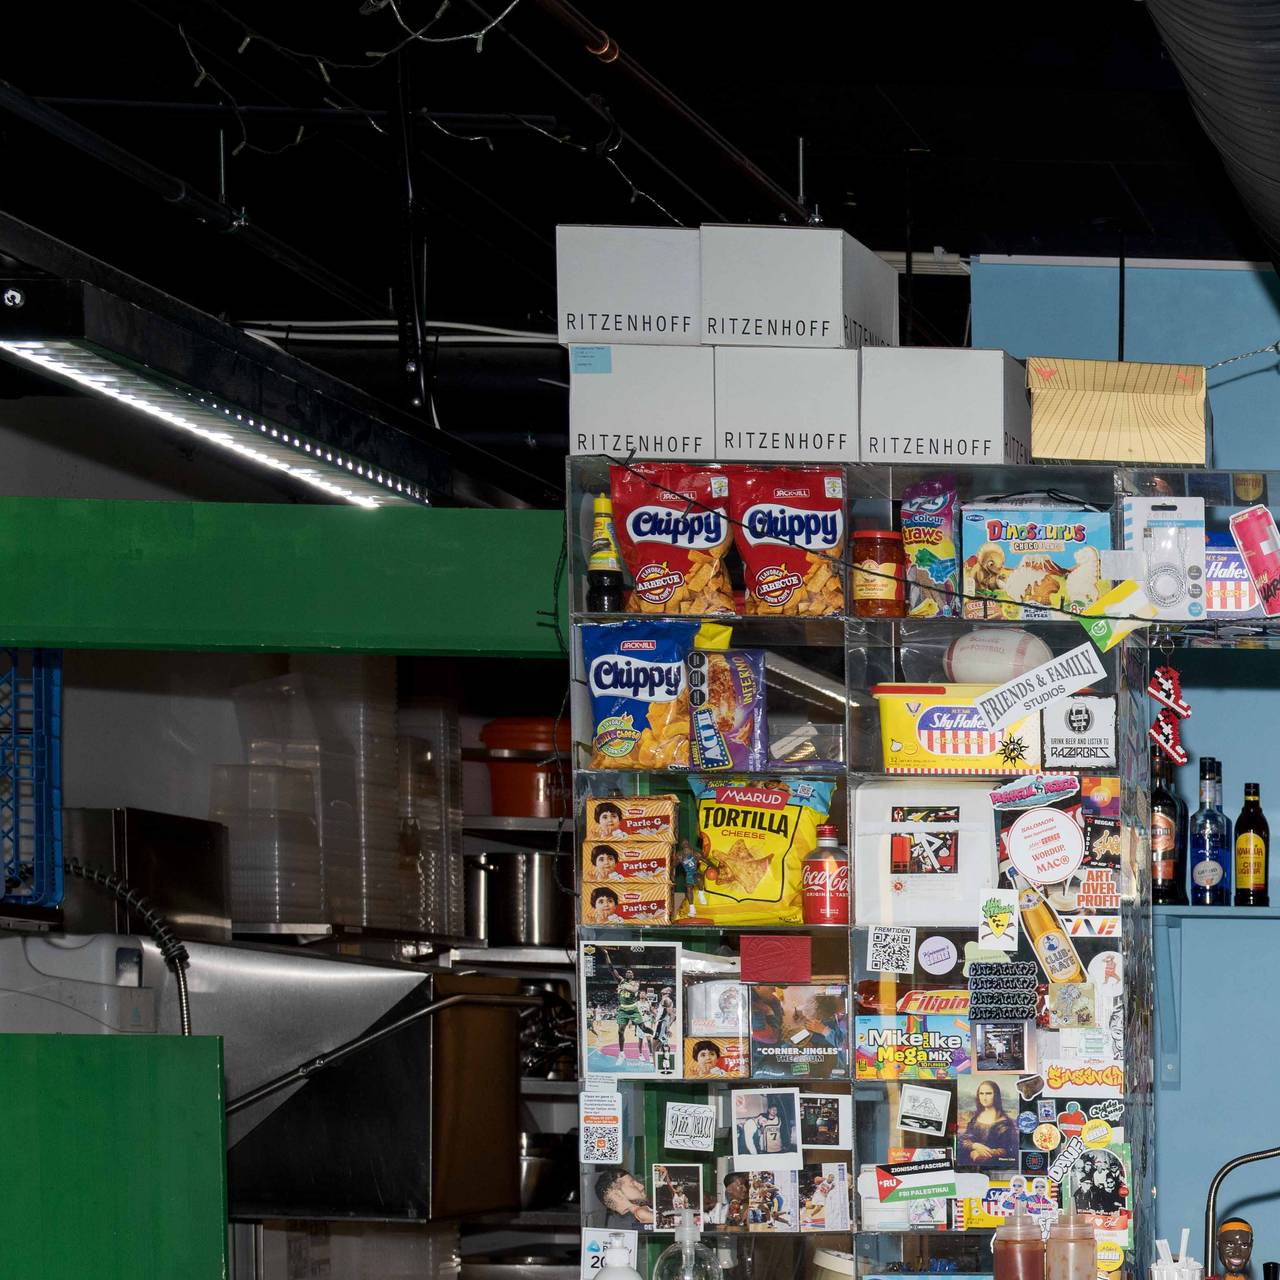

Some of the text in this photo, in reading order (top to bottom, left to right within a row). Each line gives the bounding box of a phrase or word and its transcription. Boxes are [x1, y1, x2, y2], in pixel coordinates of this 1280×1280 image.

[566, 313, 693, 333] RITZENHOFF
[707, 317, 831, 337] RITZENHOFF
[577, 433, 703, 454] RITZENHOFF
[723, 431, 848, 451] RITZENHOFF
[868, 436, 994, 457] RITZENHOFF
[631, 507, 723, 547] Chippy
[747, 506, 843, 547] Chippy
[593, 660, 682, 699] Chippy
[732, 655, 753, 705] INFERNO
[978, 648, 1099, 727] FRIENDS & FAMILY
[1023, 684, 1066, 711] STUDIOS
[719, 788, 783, 806] MAARUD
[626, 816, 662, 829] Parle-G
[702, 806, 789, 839] TORTILLA
[1020, 816, 1054, 833] SALOMON
[720, 828, 766, 841] CHEESE
[622, 859, 658, 872] Parle-G
[1086, 870, 1111, 882] ART
[1081, 883, 1116, 894] OVER
[622, 902, 658, 914] Parle-G
[1077, 895, 1121, 907] PROFIT
[873, 926, 912, 934] FREMTIDEN
[868, 1029, 962, 1049] Mike Ike
[877, 1047, 953, 1065] Mega MIX
[898, 1186, 949, 1197] FRI PALESTINA!
